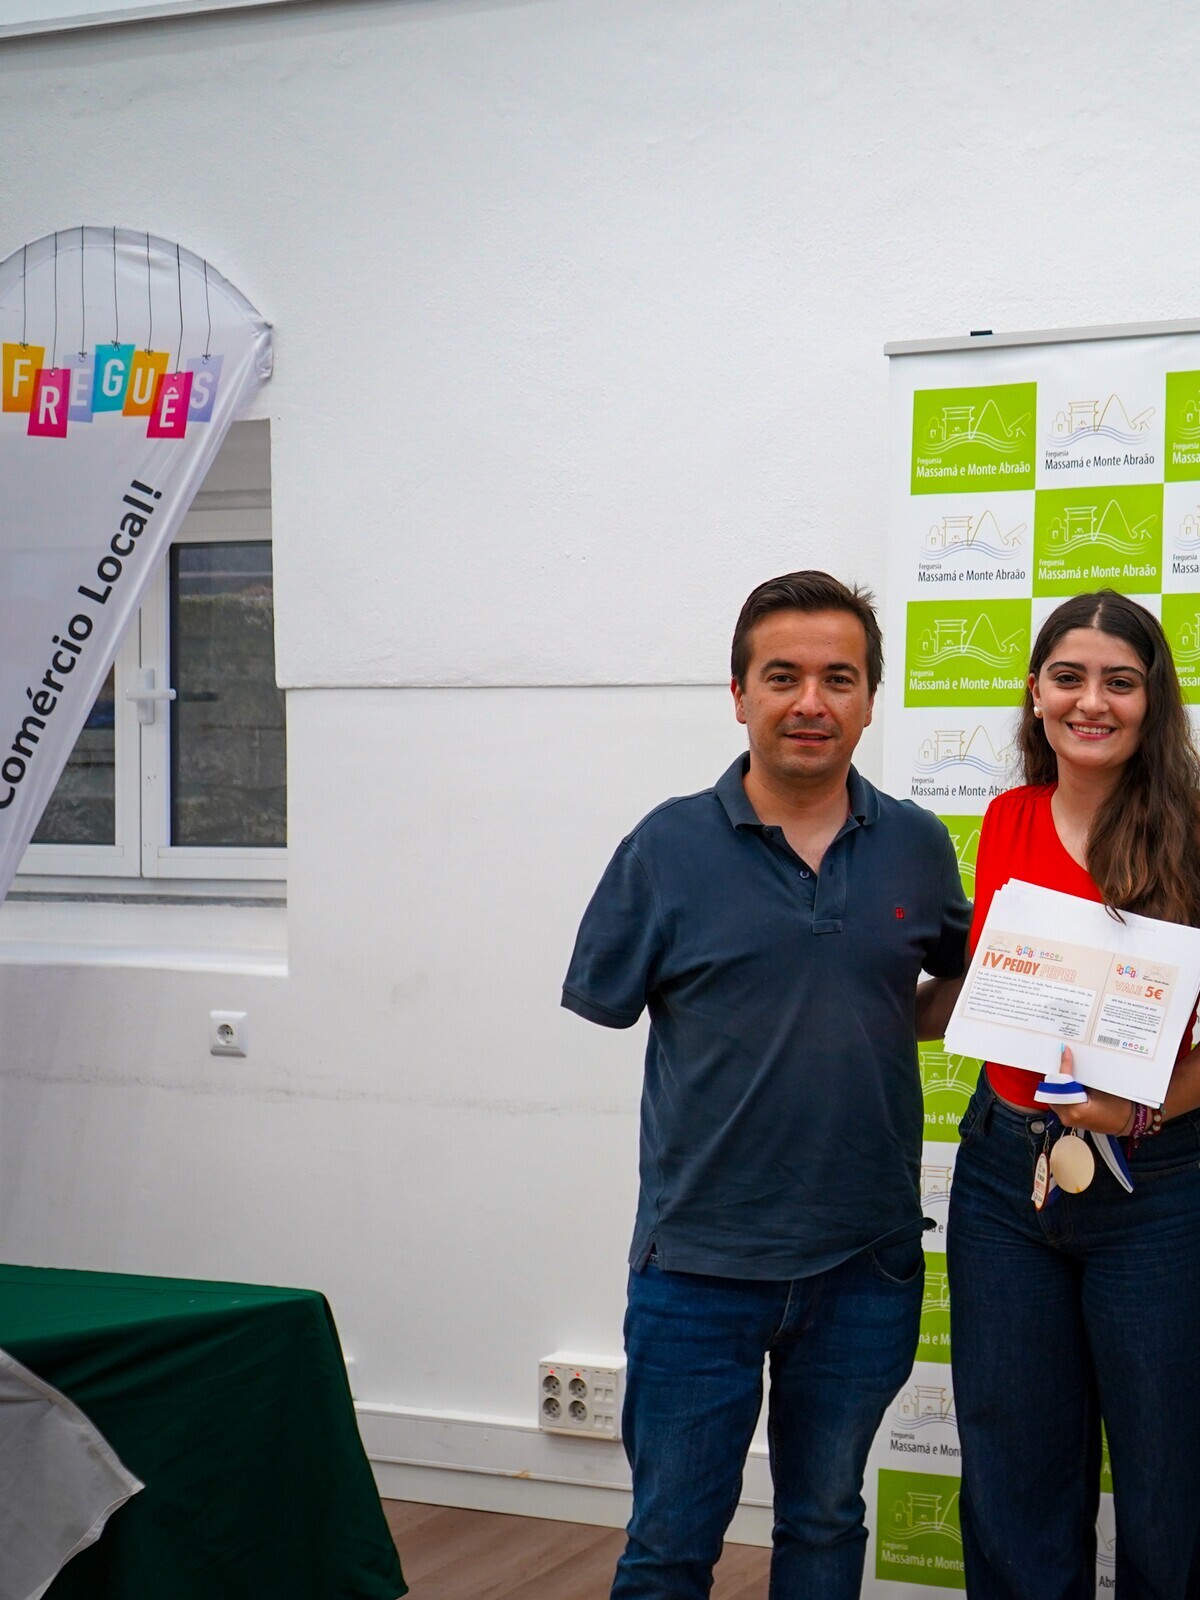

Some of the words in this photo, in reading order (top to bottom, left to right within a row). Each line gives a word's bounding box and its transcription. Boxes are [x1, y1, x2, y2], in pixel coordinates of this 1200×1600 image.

[10, 357, 213, 429] FREGUÊS
[1172, 442, 1200, 451] Freguesia
[917, 457, 942, 466] Freguesia
[1045, 450, 1069, 459] Freguesia
[1045, 457, 1084, 470] Massamá
[1086, 460, 1091, 468] e
[1093, 456, 1122, 468] Monte
[1123, 454, 1155, 466] Abraão
[916, 464, 958, 478] Massamá
[960, 467, 966, 477] e
[967, 464, 997, 476] Monte
[999, 462, 1031, 474] Abraão
[78, 479, 163, 605] Local!
[1039, 558, 1065, 567] Freguesia
[1172, 553, 1198, 562] Freguesia
[918, 563, 942, 571] Freguesia
[1038, 565, 1081, 580] Massamá
[1082, 569, 1089, 578] e
[1090, 565, 1121, 577] Monte
[1122, 563, 1157, 576] Abraão
[918, 569, 957, 582] Massamá
[958, 572, 964, 580] e
[966, 569, 994, 581] Monte
[995, 568, 1026, 580] Abraão
[910, 669, 934, 678] Freguesia
[909, 677, 951, 691] Massamá
[952, 681, 958, 690] e
[959, 677, 990, 690] Monte
[991, 677, 1024, 690] Abraão
[911, 784, 949, 796] Massamá
[951, 787, 957, 796] e
[958, 785, 987, 797] Monte
[982, 951, 1004, 968] IV
[1002, 957, 1041, 976] PEDDY
[1144, 985, 1164, 1000] 5€
[890, 1439, 931, 1455] Massamá
[932, 1446, 938, 1455] e
[940, 1444, 960, 1457] Mon
[881, 1549, 925, 1566] Massamá
[926, 1557, 933, 1568] e
[934, 1555, 964, 1572] Monte
